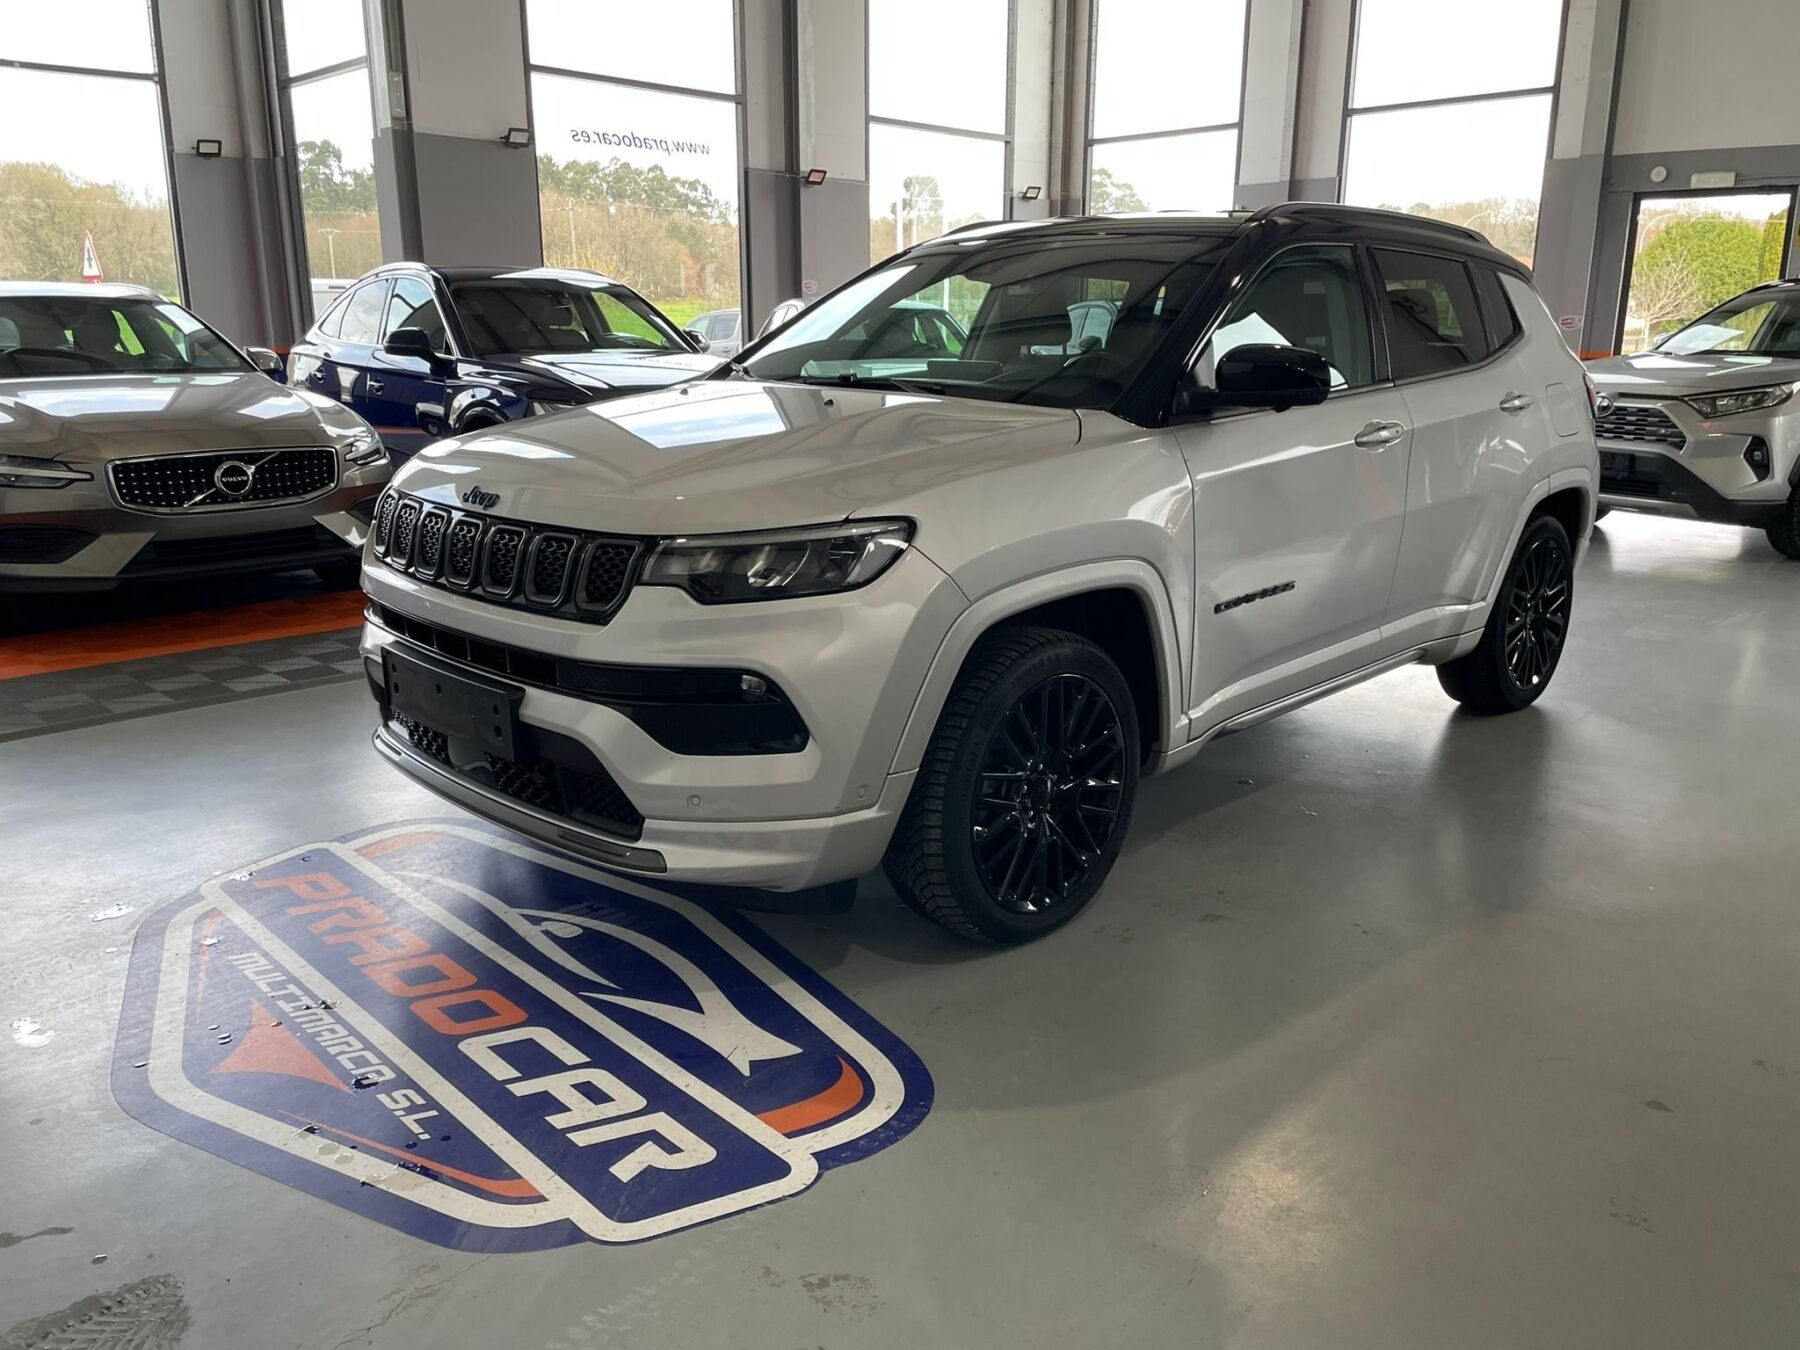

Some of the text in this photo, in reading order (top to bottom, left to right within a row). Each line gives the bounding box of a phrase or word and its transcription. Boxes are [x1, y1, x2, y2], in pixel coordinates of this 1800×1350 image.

[221, 475, 248, 483] VOLVO
[462, 485, 500, 511] Jeep
[227, 952, 440, 1140] MULTIMARCA S.L.
